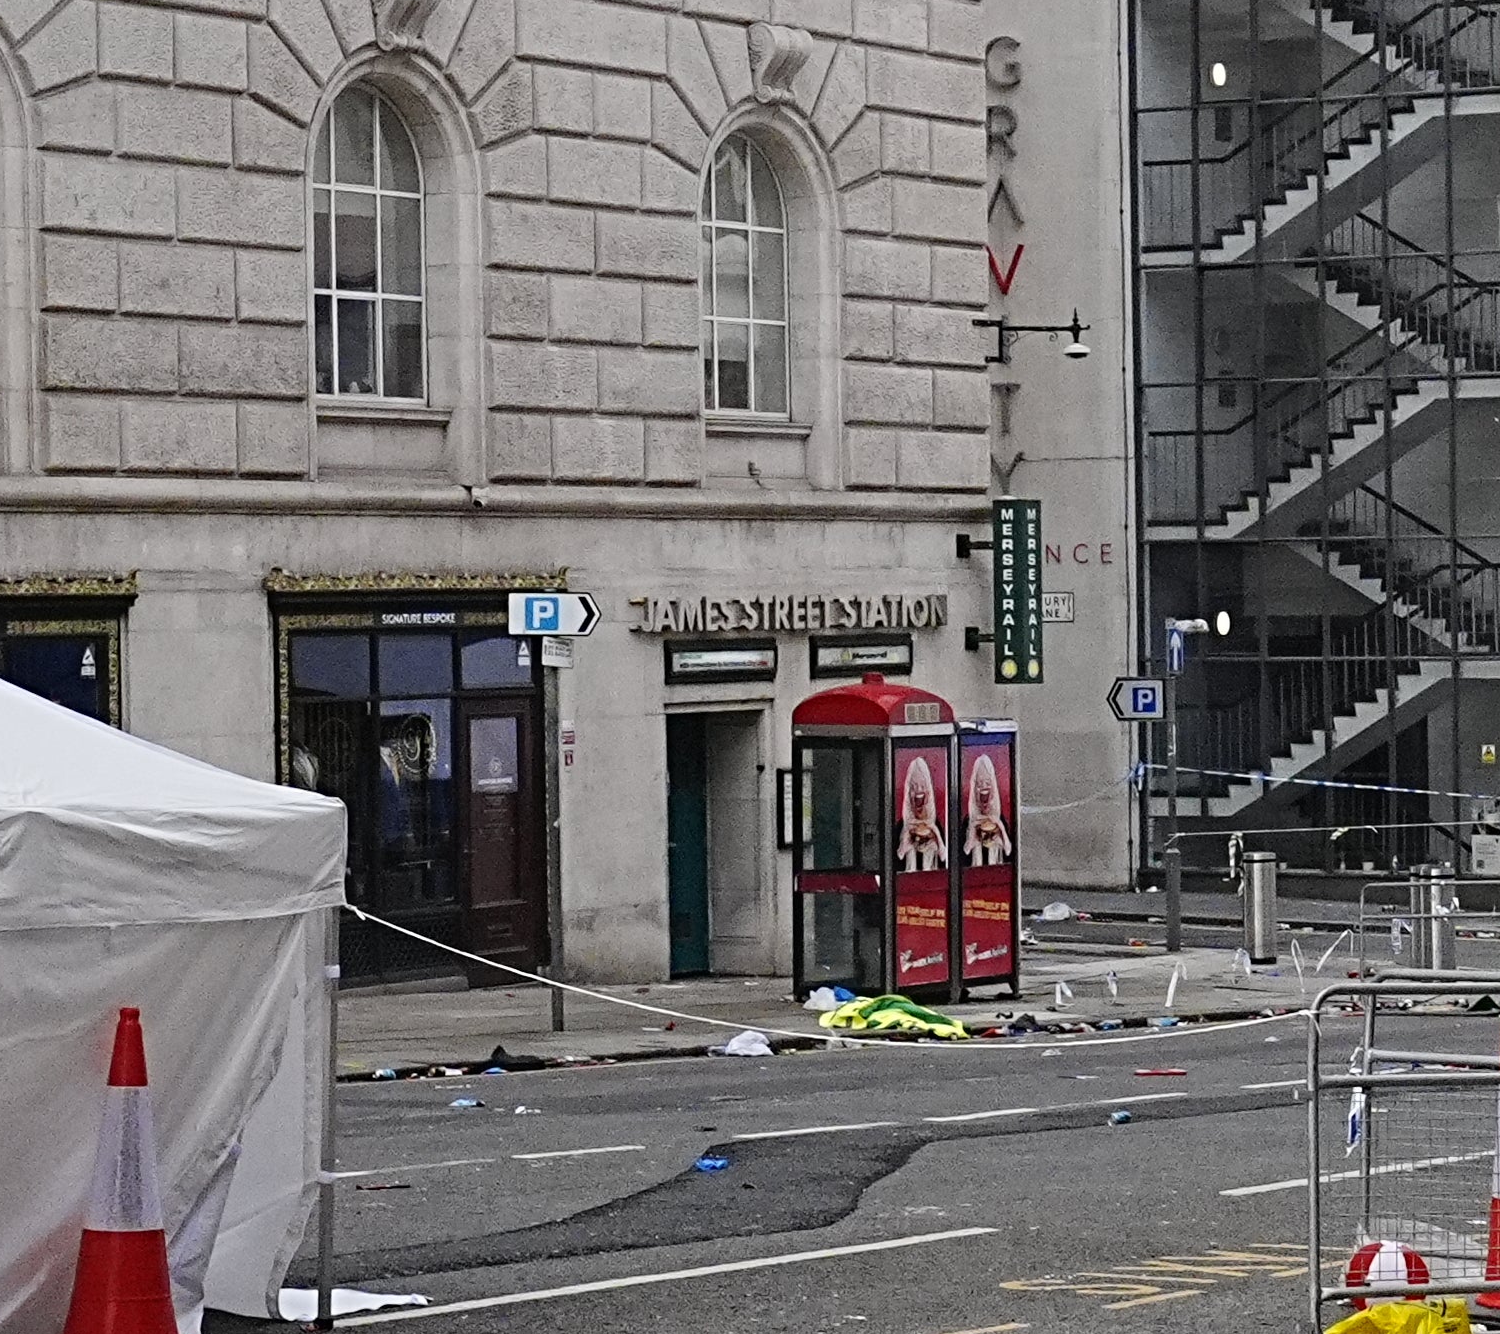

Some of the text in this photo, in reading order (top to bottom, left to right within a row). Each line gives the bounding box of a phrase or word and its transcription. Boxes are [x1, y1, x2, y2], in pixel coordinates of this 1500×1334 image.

[1000, 508, 1015, 656] MERSEYRAIL
[1026, 508, 1037, 656] MERSEYRAIL
[381, 612, 456, 625] SIGNATURE BESPOKE
[532, 600, 554, 629] P
[642, 593, 948, 633] JAMES STREET STATION
[1137, 689, 1153, 711] P
